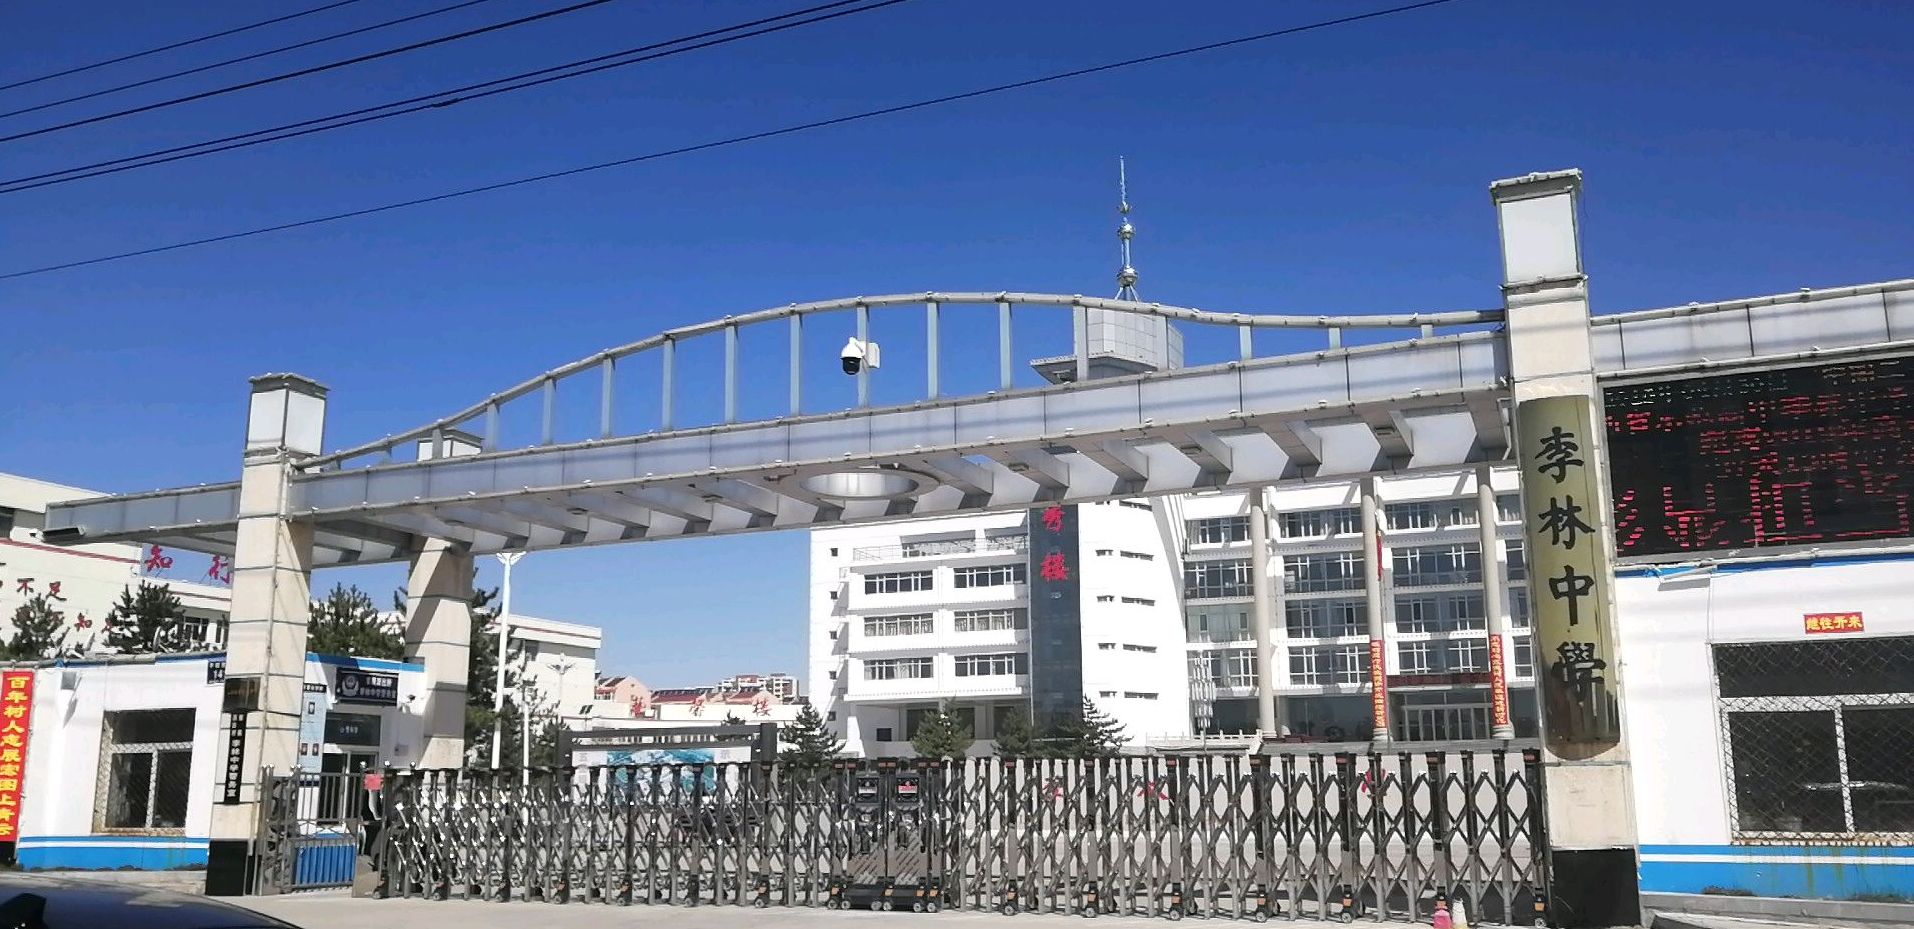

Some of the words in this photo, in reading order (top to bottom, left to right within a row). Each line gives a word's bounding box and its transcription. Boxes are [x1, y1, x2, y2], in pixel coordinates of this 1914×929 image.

[0, 576, 67, 601] 不足
[1807, 615, 1862, 630] 继往开来
